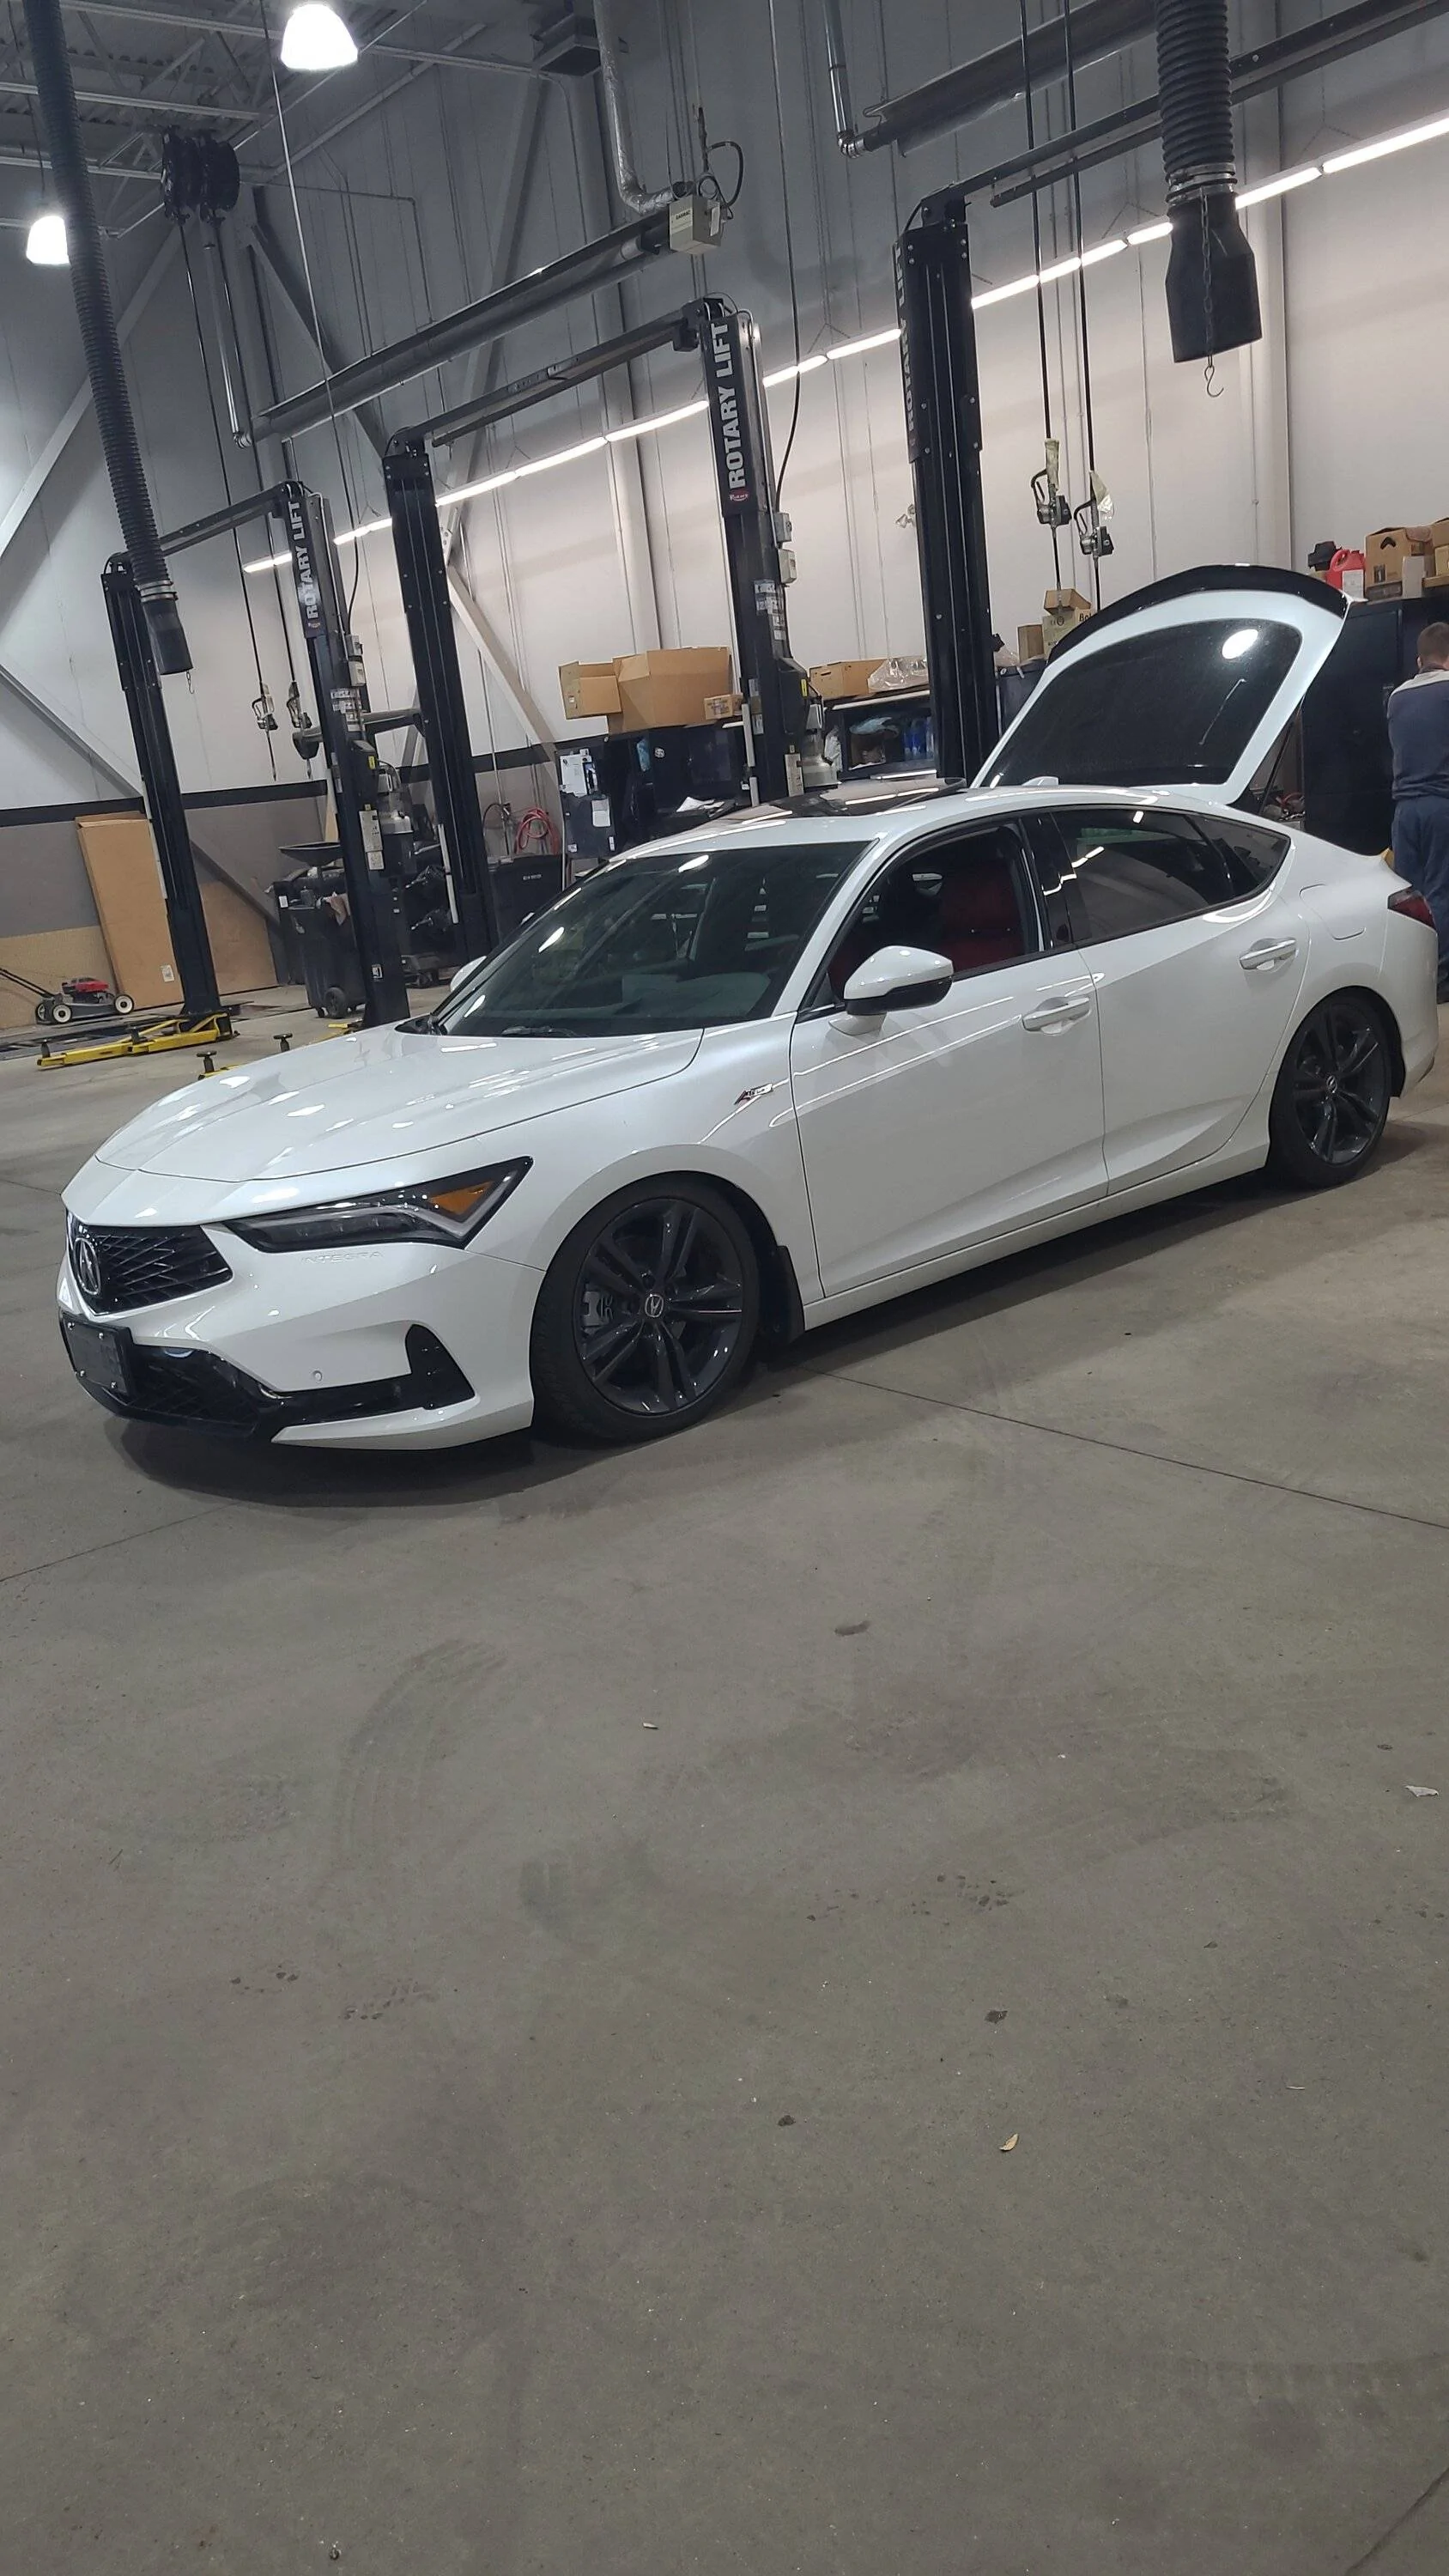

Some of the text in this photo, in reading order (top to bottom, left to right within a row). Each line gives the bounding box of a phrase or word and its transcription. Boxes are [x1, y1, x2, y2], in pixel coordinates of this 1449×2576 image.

[711, 323, 746, 489] ROTARY LIFT
[288, 501, 306, 540] LIFT
[295, 545, 318, 619] ROTARY
